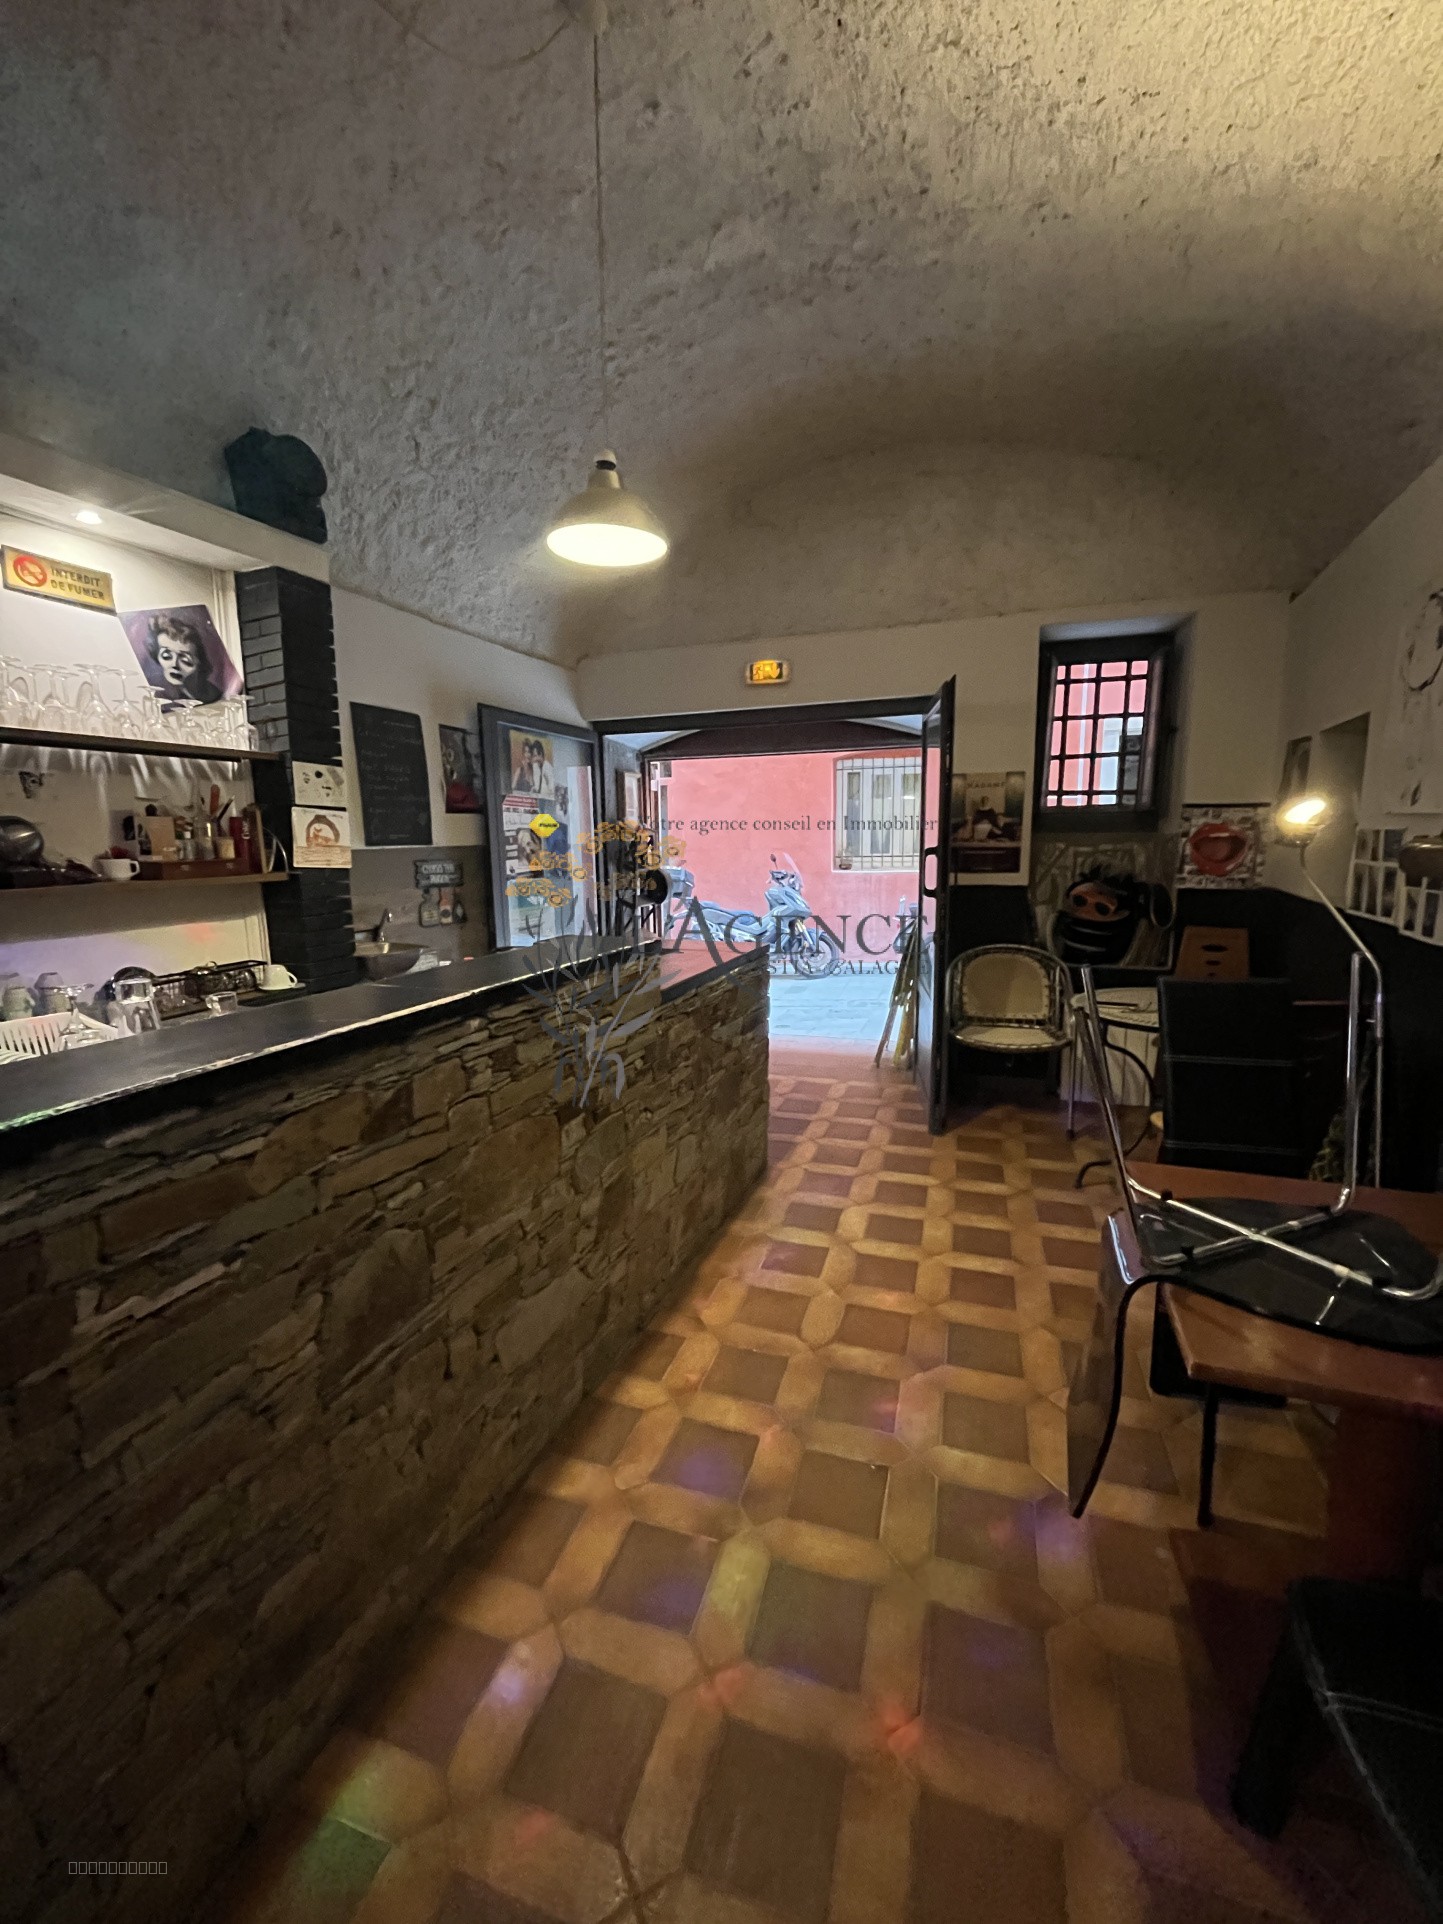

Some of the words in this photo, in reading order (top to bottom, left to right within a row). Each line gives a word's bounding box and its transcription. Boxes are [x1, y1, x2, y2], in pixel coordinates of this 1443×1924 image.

[50, 567, 101, 587] INTERDIT
[50, 579, 66, 591] DE
[67, 582, 105, 600] FUMER
